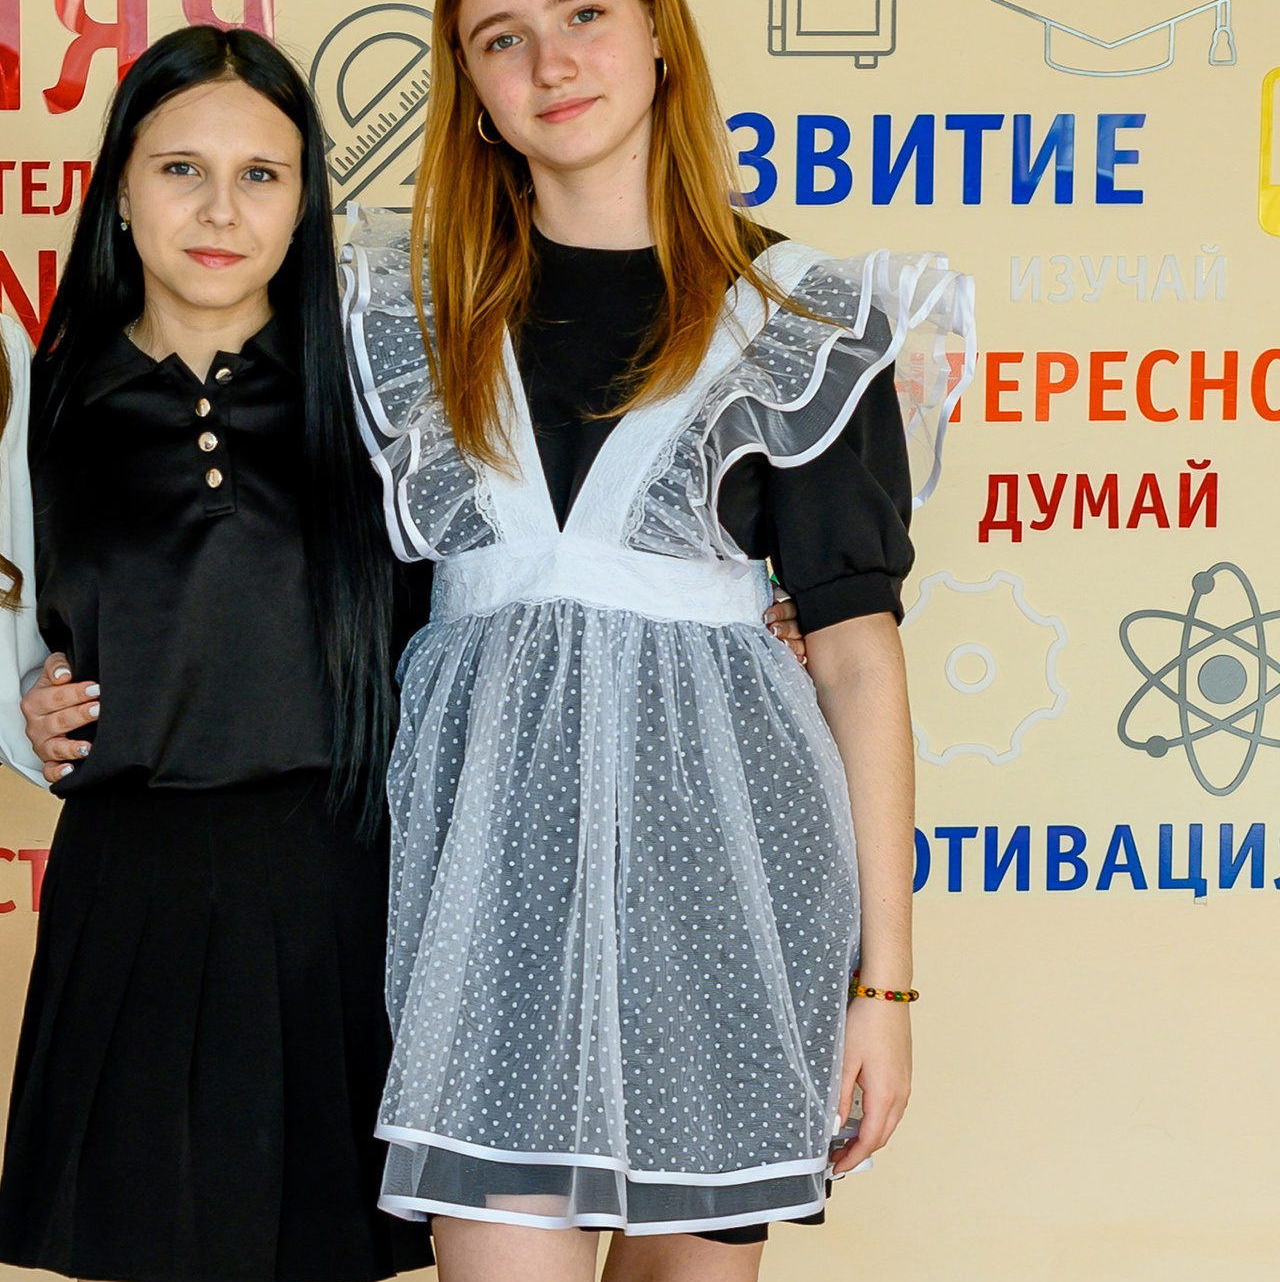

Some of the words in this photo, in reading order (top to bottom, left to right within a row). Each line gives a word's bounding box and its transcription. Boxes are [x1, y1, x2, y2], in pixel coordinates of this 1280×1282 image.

[723, 111, 1147, 207] ЗВИТИЕ
[1009, 244, 1227, 302] ИЗУЧАЙ
[977, 458, 1219, 544] ДУМАЙ
[912, 823, 1280, 899] ТИВАЦИ
